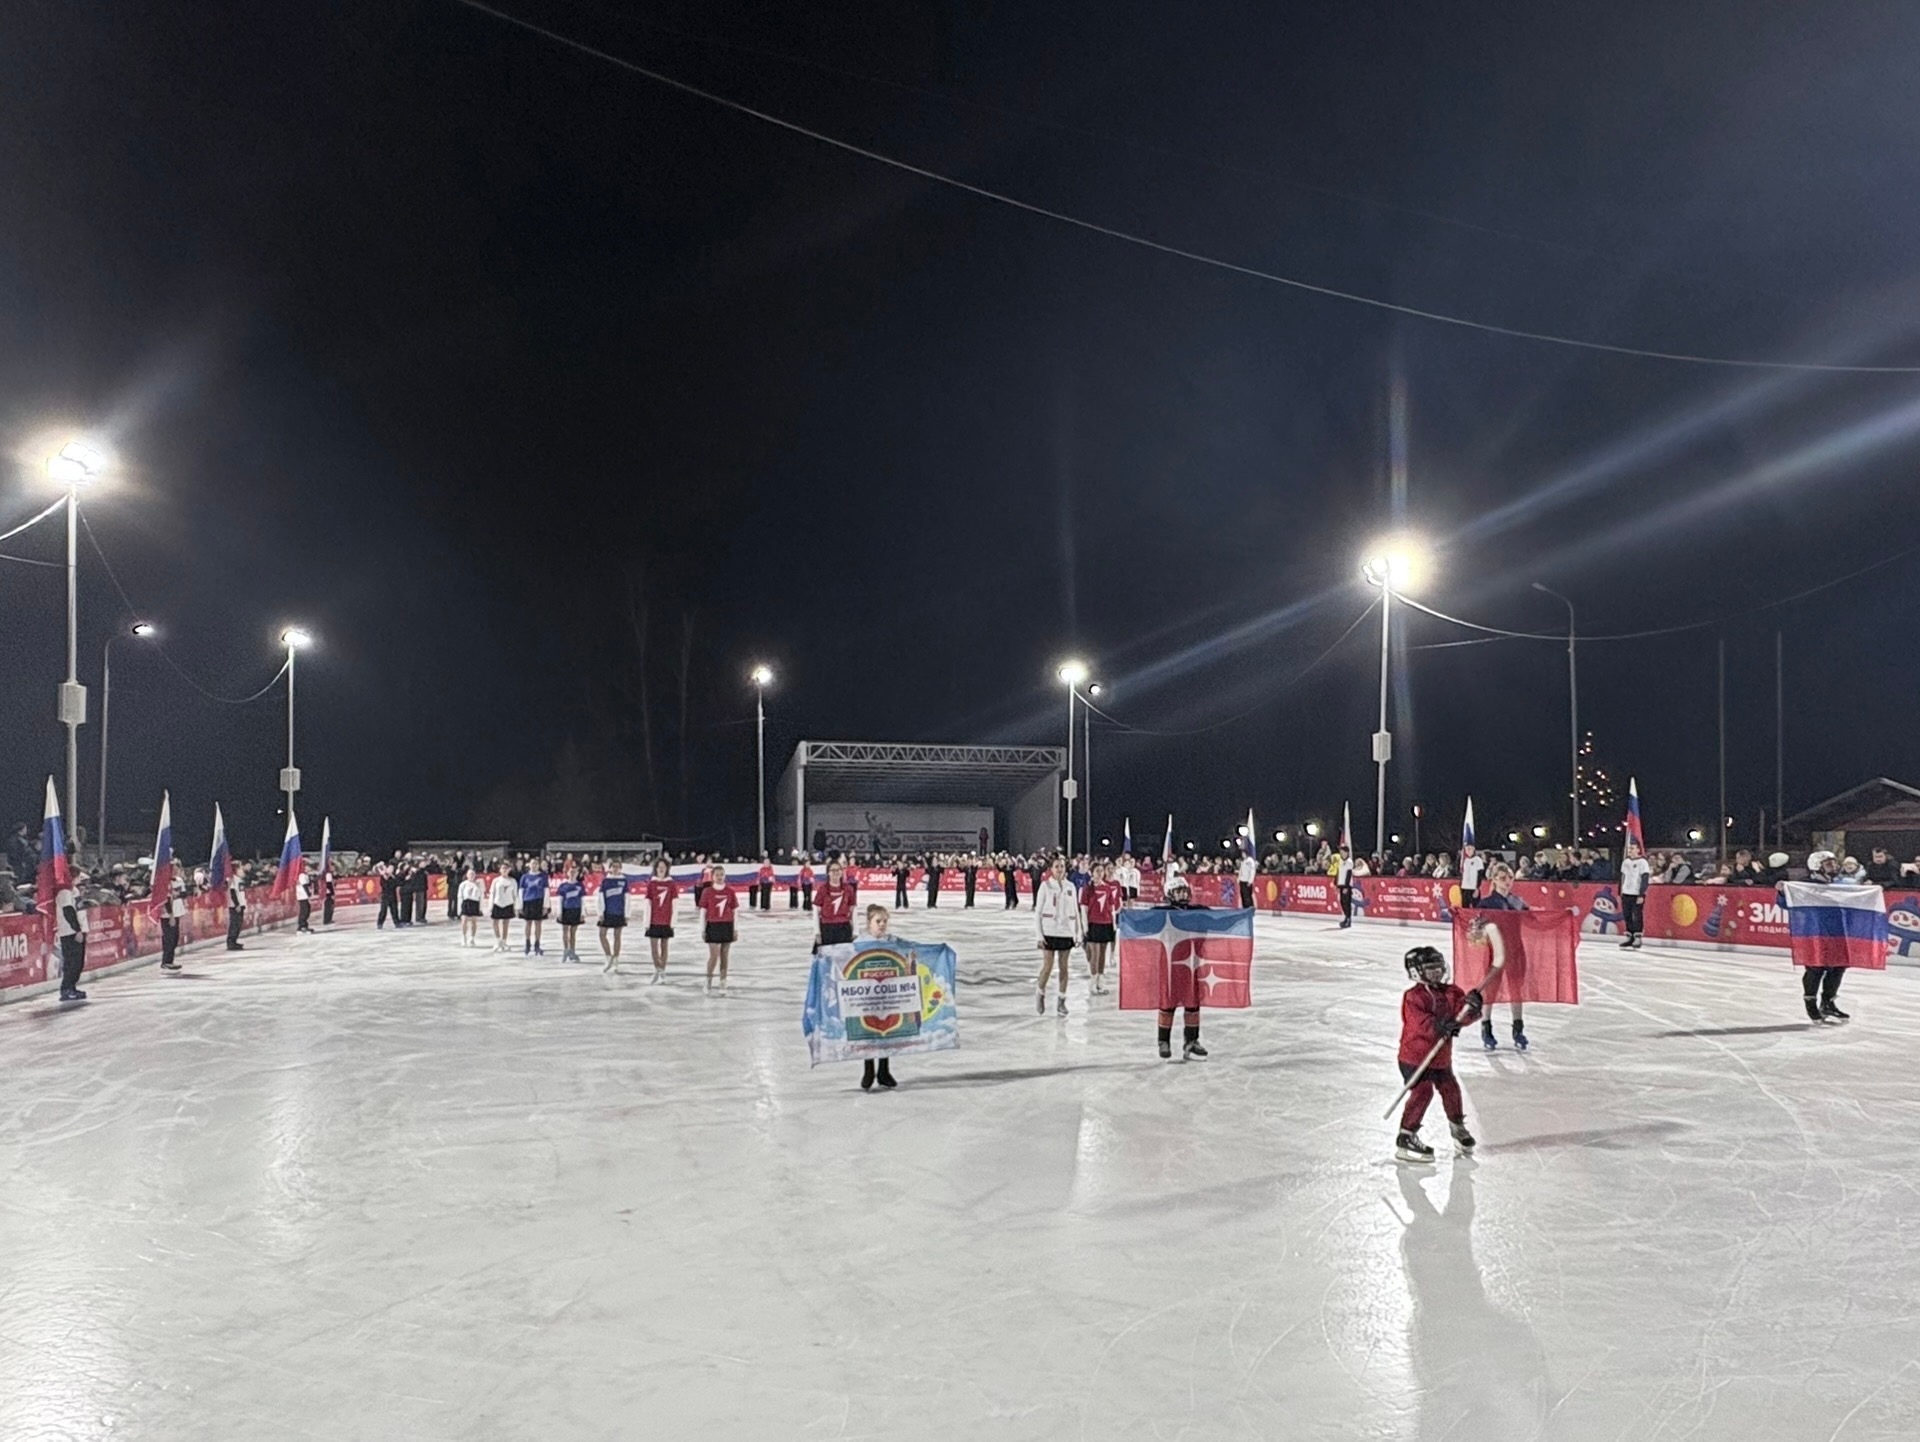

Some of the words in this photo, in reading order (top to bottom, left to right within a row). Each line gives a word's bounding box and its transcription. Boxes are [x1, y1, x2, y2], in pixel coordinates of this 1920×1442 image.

[826, 834, 866, 849] 2026
[841, 985, 871, 996] МБОУ
[874, 984, 897, 994] СОШ
